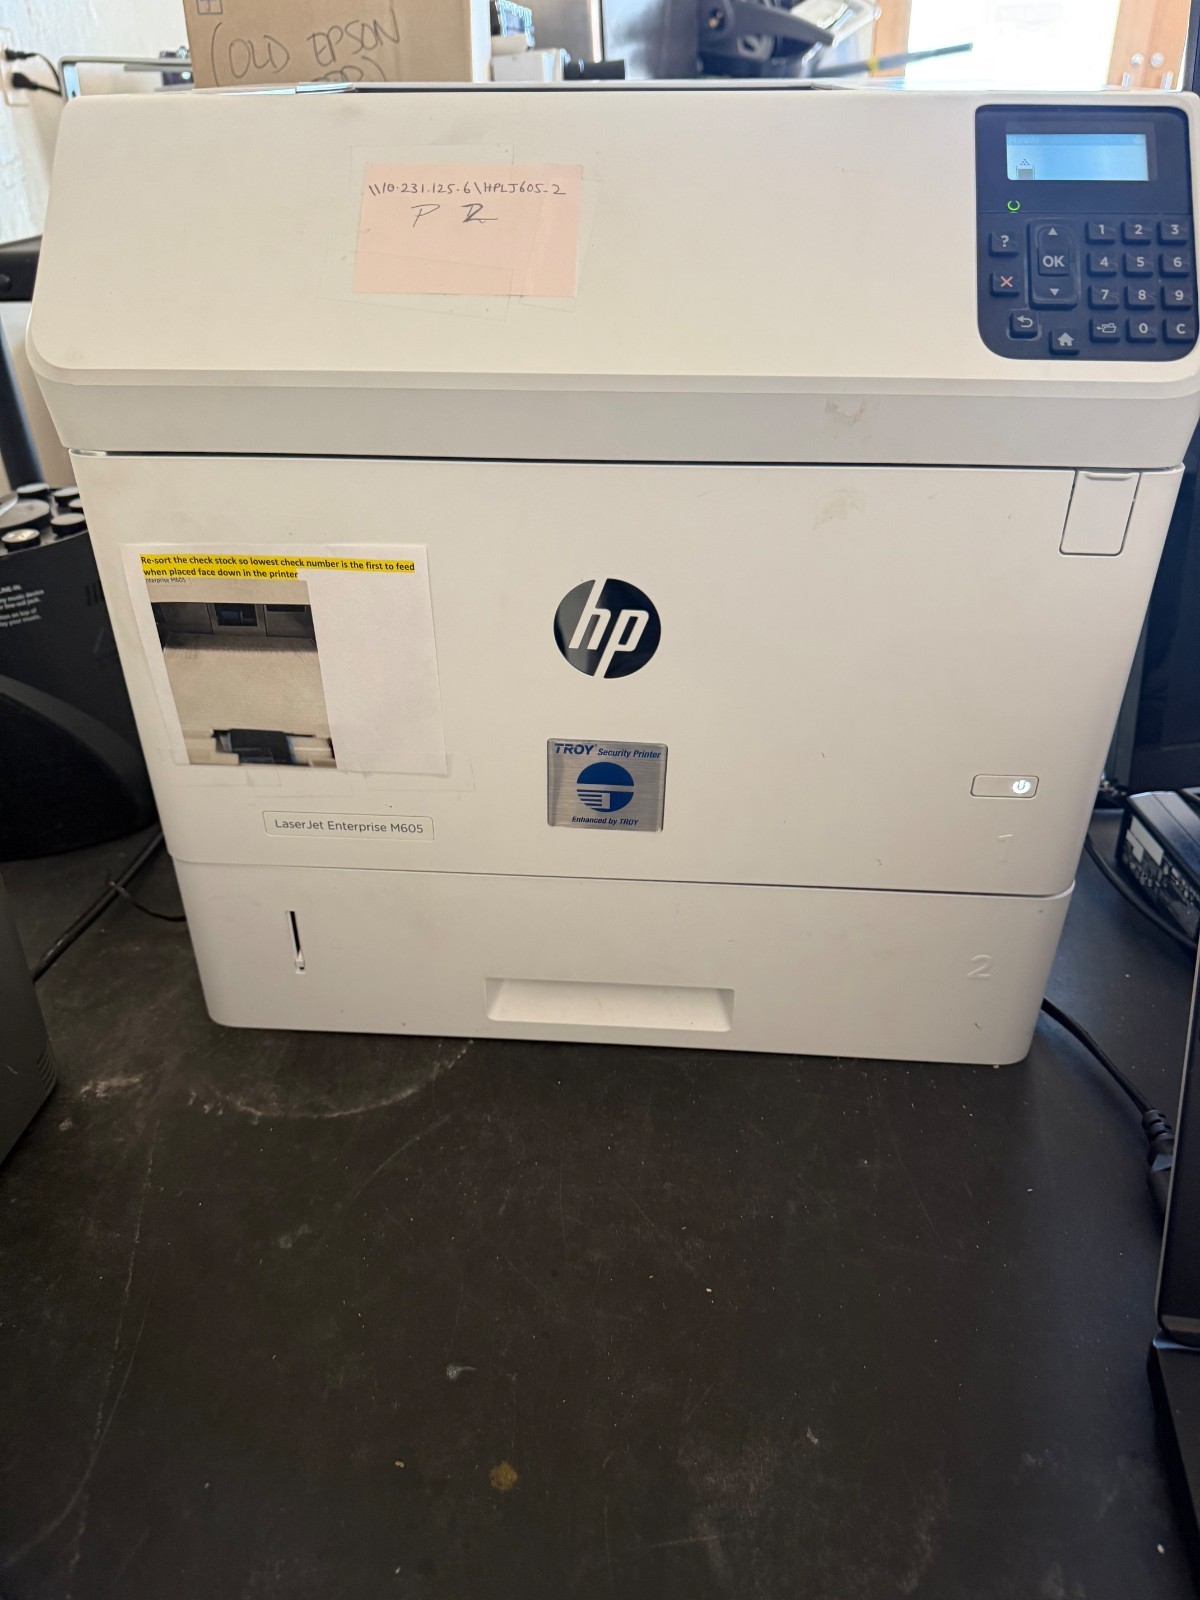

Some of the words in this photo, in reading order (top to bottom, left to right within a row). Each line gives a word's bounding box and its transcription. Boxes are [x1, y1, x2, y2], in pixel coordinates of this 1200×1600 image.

[306, 7, 400, 67] EPSON
[1099, 224, 1105, 235] 1
[1134, 224, 1143, 235] 2
[1171, 224, 1180, 235] 3
[1042, 255, 1065, 268] OK
[1100, 257, 1109, 267] 4
[1136, 257, 1145, 267] 5
[1173, 257, 1182, 268] 6
[1101, 290, 1109, 300] 7
[1138, 290, 1147, 301] 8
[1175, 290, 1184, 300] 9
[1138, 323, 1149, 334] 0
[1176, 323, 1186, 335] C
[140, 556, 172, 564] Re-sort
[173, 556, 188, 564] the
[189, 556, 214, 565] check
[214, 556, 237, 565] stock
[250, 557, 279, 566] lowest
[280, 558, 305, 567] check
[306, 559, 339, 568] number
[341, 560, 348, 568] is
[350, 560, 364, 569] the
[366, 561, 384, 570] first
[384, 562, 394, 570] to
[395, 562, 415, 571] feed
[143, 568, 167, 576] when
[169, 567, 197, 577] placed
[198, 568, 216, 576] face
[217, 568, 241, 577] down
[242, 569, 252, 577] in
[253, 569, 267, 578] the
[269, 570, 298, 579] printer
[568, 578, 650, 679] hp
[597, 748, 632, 759] Security
[633, 750, 661, 759] Printer
[274, 818, 324, 830] LaserJet
[327, 820, 387, 833] Enterprise
[390, 823, 424, 834] M605
[571, 816, 607, 824] Enhanced
[608, 817, 618, 826] by
[619, 818, 640, 826] TROY
[967, 954, 992, 979] 2
